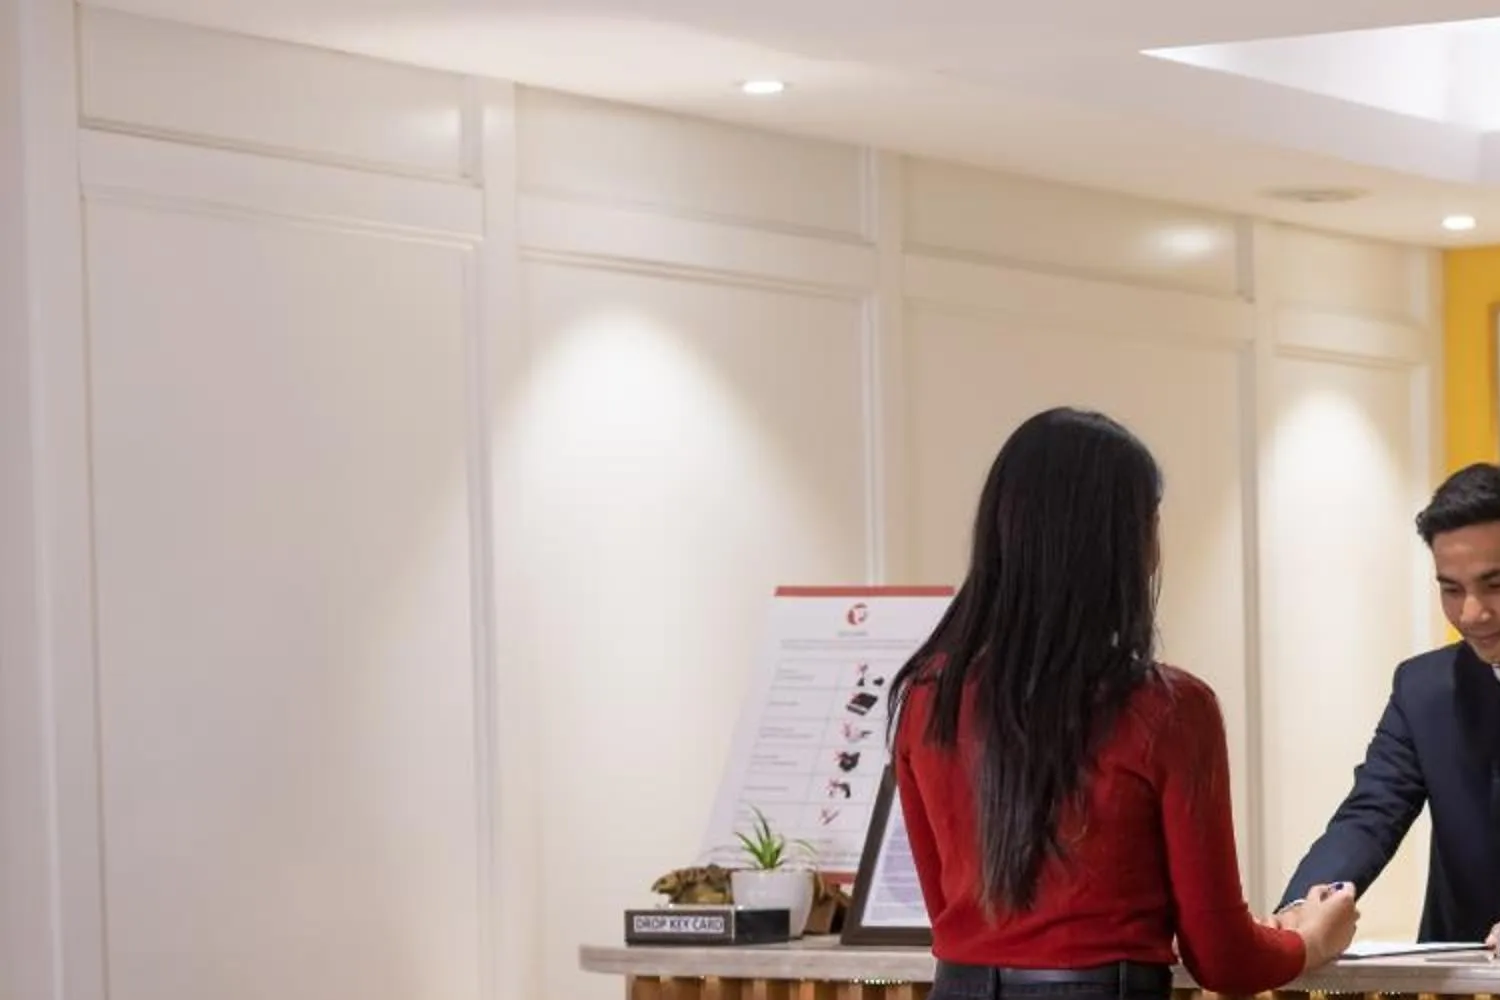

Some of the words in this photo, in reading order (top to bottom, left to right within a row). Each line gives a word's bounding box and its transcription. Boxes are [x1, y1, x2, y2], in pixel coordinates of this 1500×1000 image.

[635, 916, 667, 930] DROP
[669, 917, 689, 930] KEY
[692, 917, 723, 931] CARD
